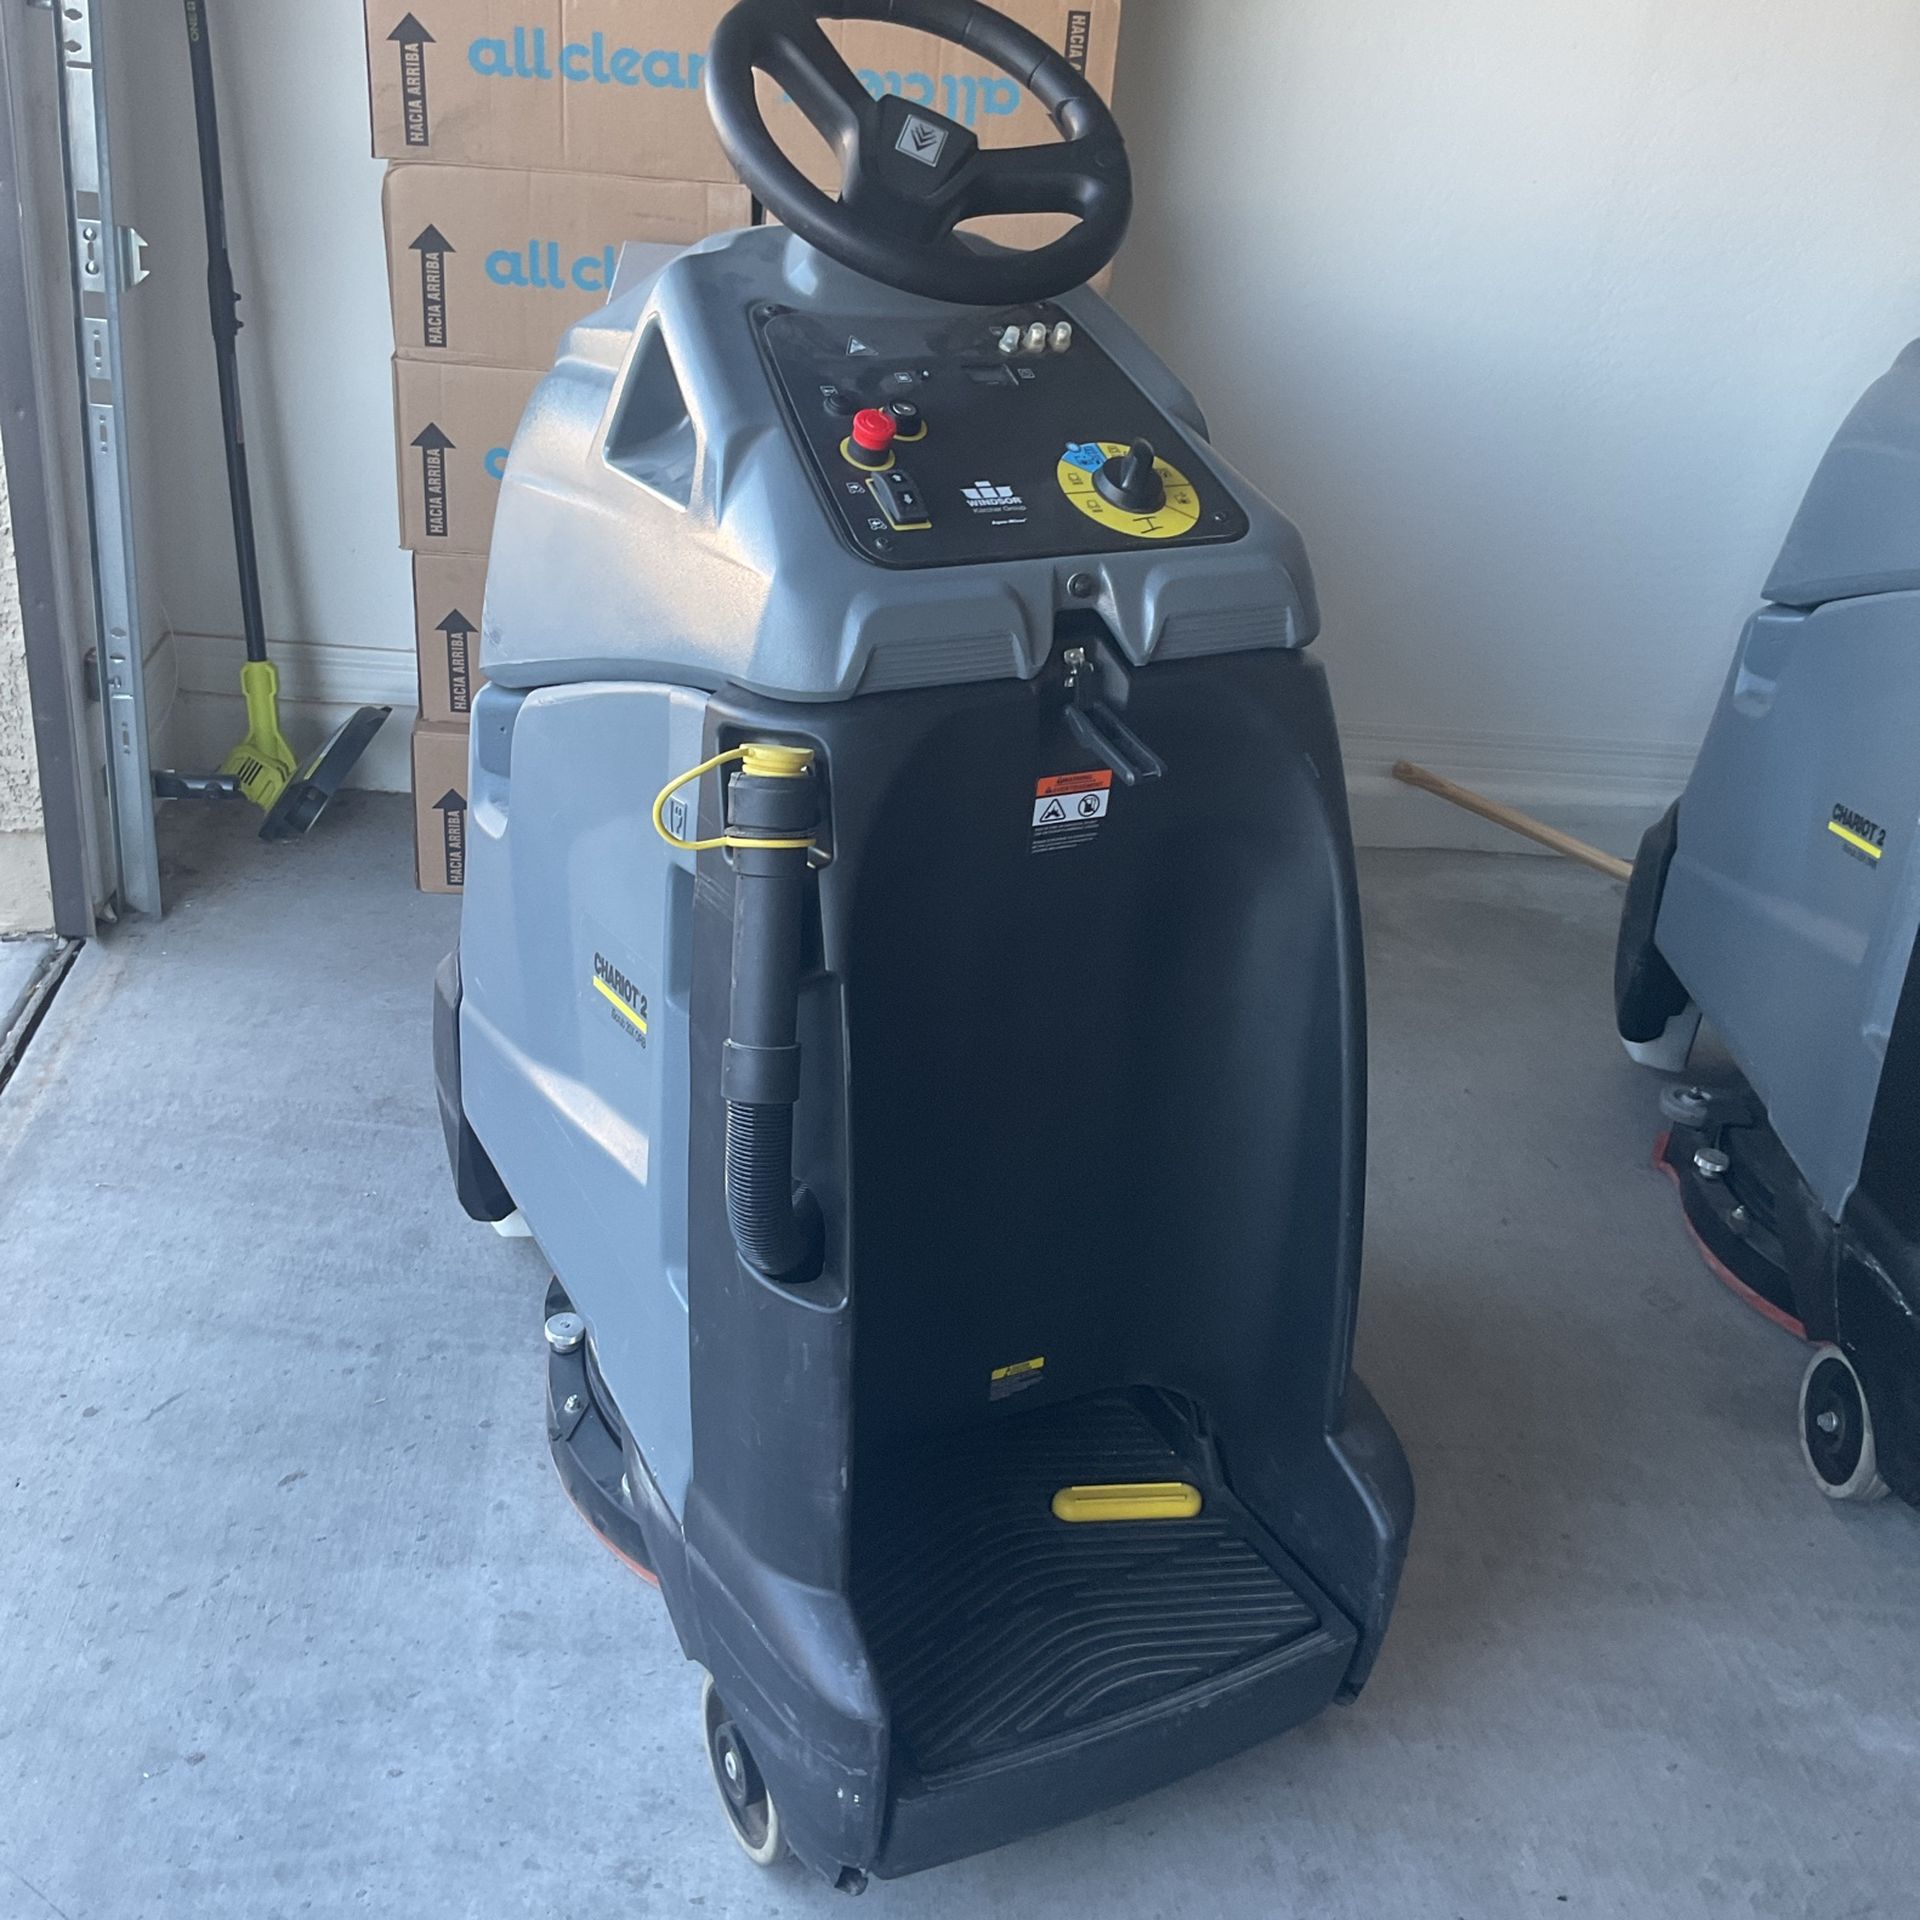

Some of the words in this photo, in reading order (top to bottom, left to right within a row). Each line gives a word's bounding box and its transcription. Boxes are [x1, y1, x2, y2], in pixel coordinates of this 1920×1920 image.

[468, 25, 553, 80] all
[558, 31, 705, 90] clear
[1068, 15, 1086, 58] HACIA
[404, 43, 422, 96] ARRIBA
[407, 99, 425, 142] HACIA
[425, 251, 442, 301] ARRIBA
[484, 239, 566, 290] all
[427, 303, 443, 344] HACIA
[426, 448, 443, 494] ARRIBA
[428, 496, 444, 534] HACIA
[965, 496, 1023, 508] WINDSOR
[450, 631, 466, 674] ARRIBA
[452, 676, 468, 711] HACIA
[446, 809, 462, 849] ARRIBA
[1832, 803, 1880, 842] CHARIOT
[1876, 828, 1887, 847] 2
[448, 851, 463, 884] HACIA
[593, 951, 640, 1009] CHARIOT
[640, 994, 648, 1019] 2
